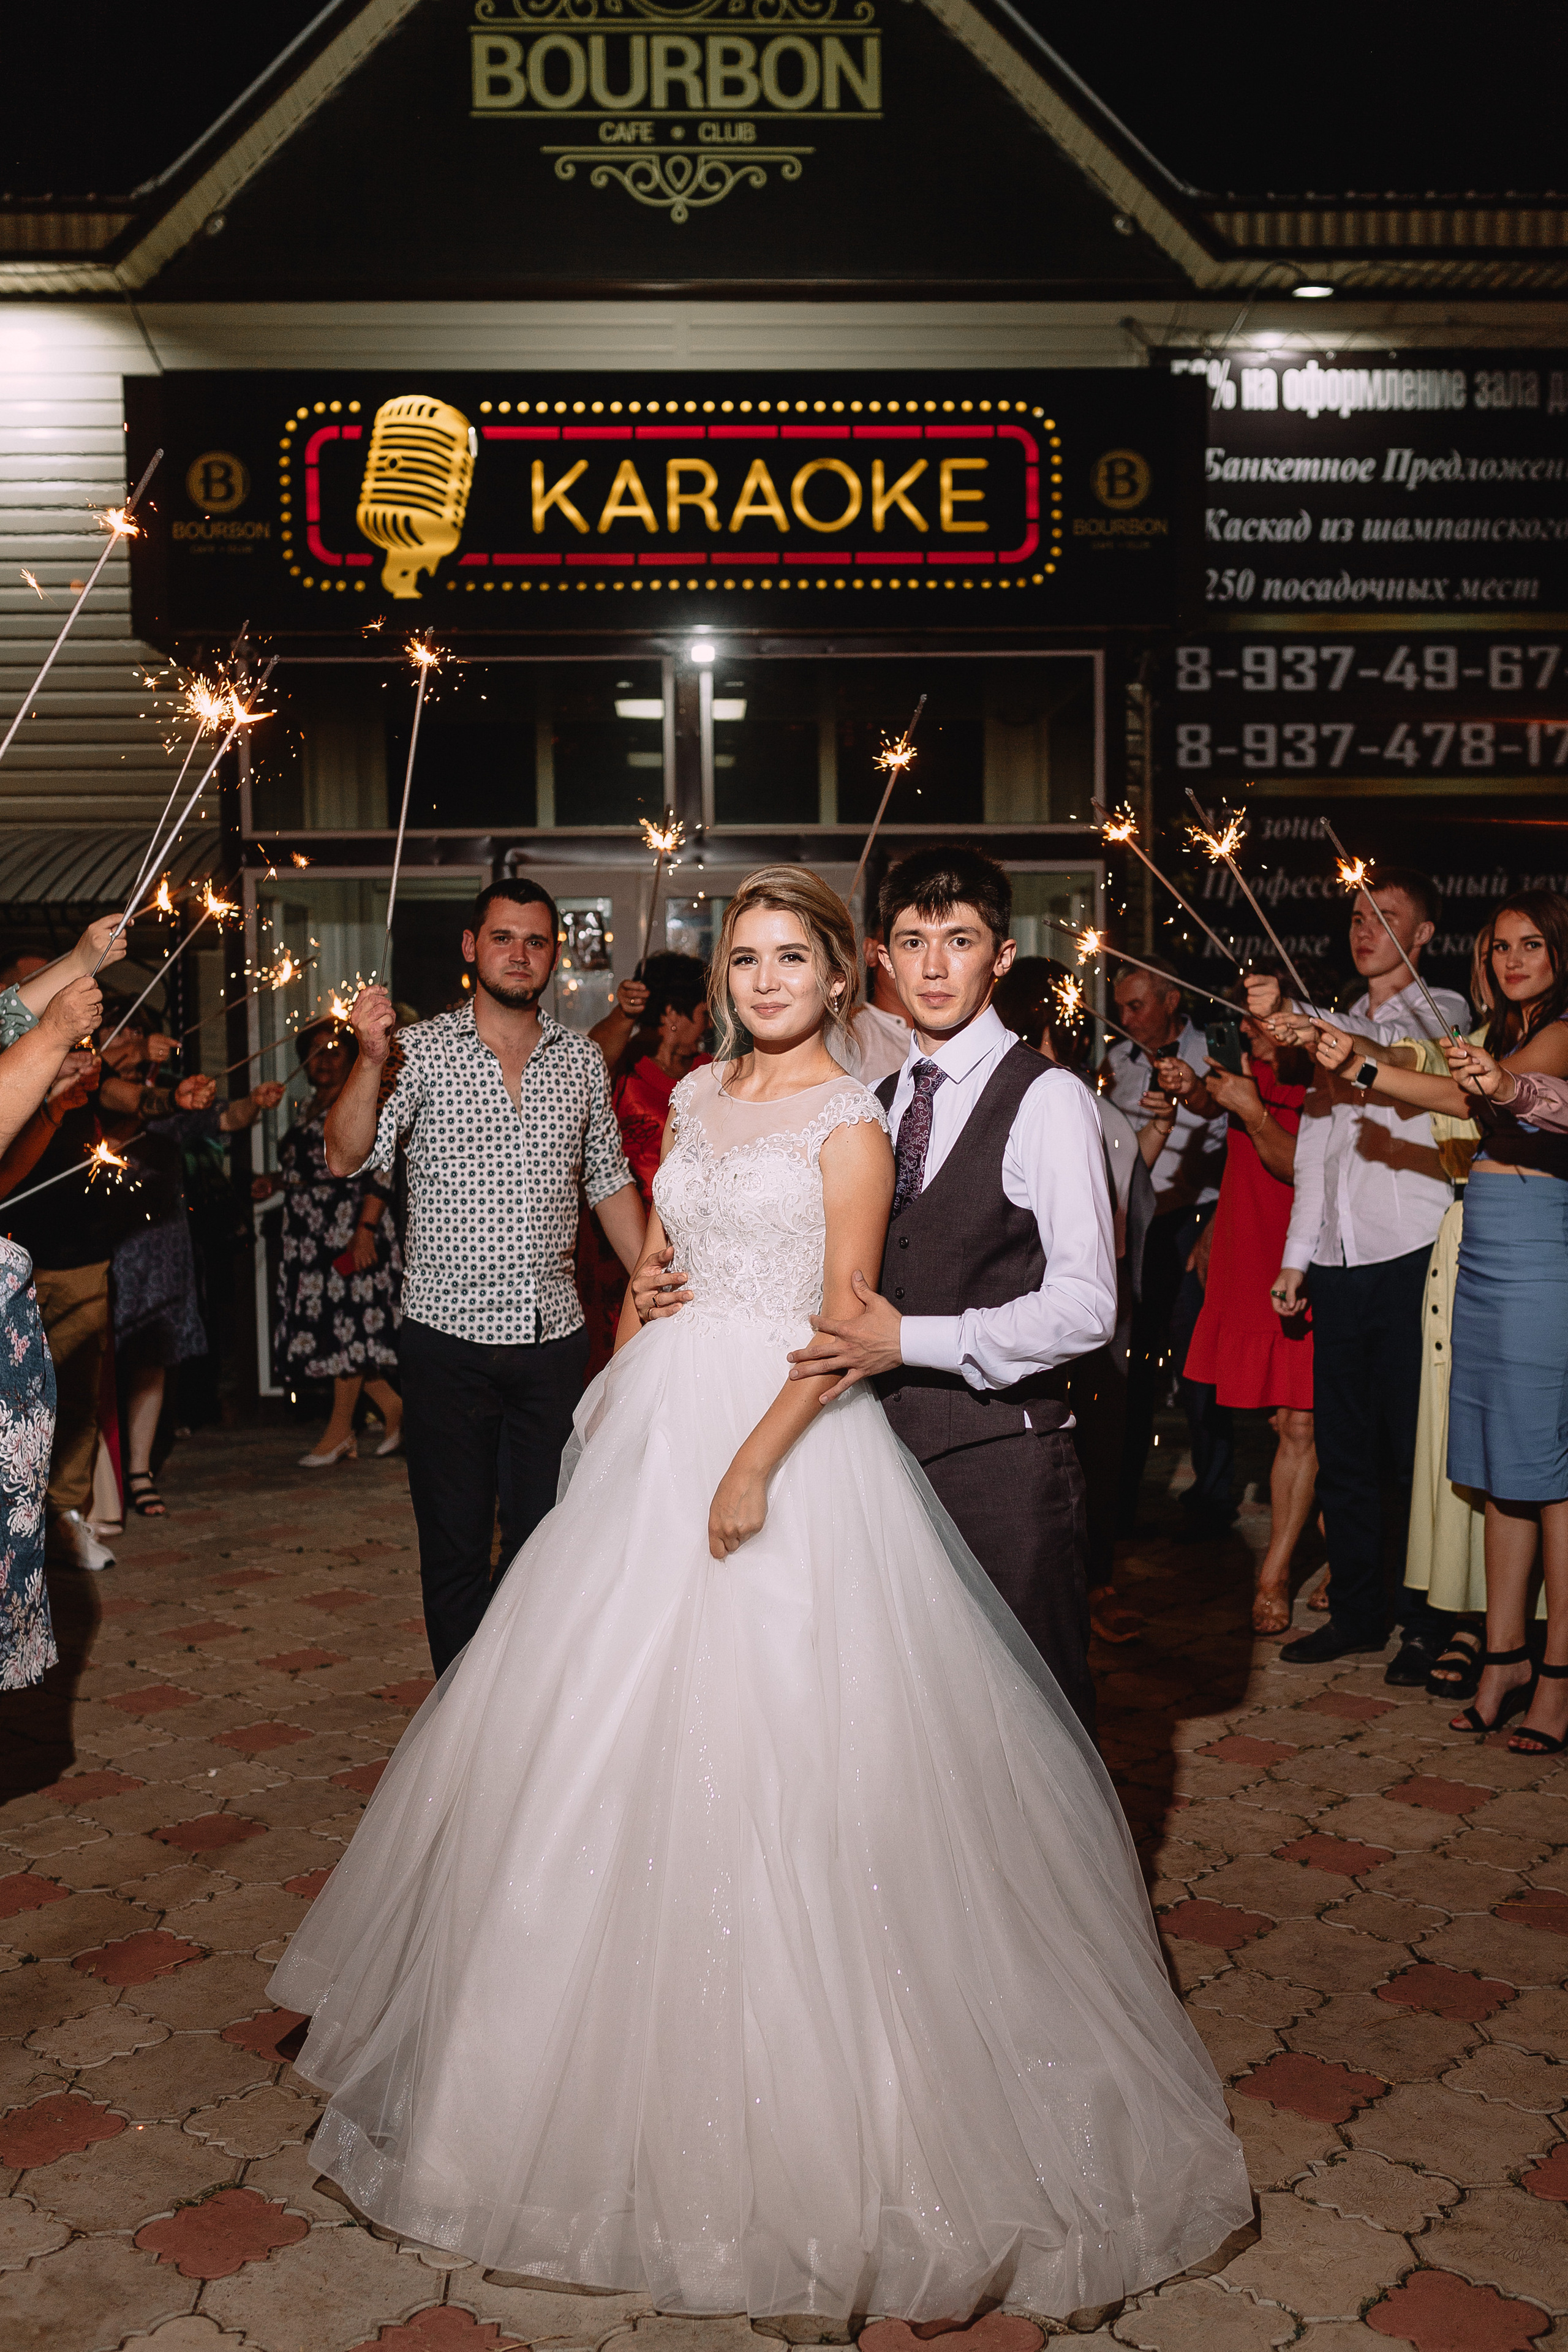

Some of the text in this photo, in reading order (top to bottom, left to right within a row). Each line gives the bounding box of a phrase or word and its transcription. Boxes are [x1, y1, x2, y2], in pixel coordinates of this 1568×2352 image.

[471, 34, 881, 110] BOURBON
[598, 121, 757, 145] CAFE CLUB
[1241, 368, 1278, 410] на
[1282, 360, 1468, 419] оформление
[1473, 369, 1541, 410] зала
[1205, 447, 1568, 491] Банкетное Предложен
[532, 458, 989, 534] KARAOKE
[172, 521, 271, 540] BOURBON
[1072, 518, 1168, 536] BOURBON
[1205, 508, 1313, 543] Каскад
[1319, 517, 1355, 543] из
[1205, 567, 1541, 602] 250 посадочных мест
[1175, 645, 1568, 692] 8-937-49-67
[1175, 722, 1568, 769] 8-937-478-17
